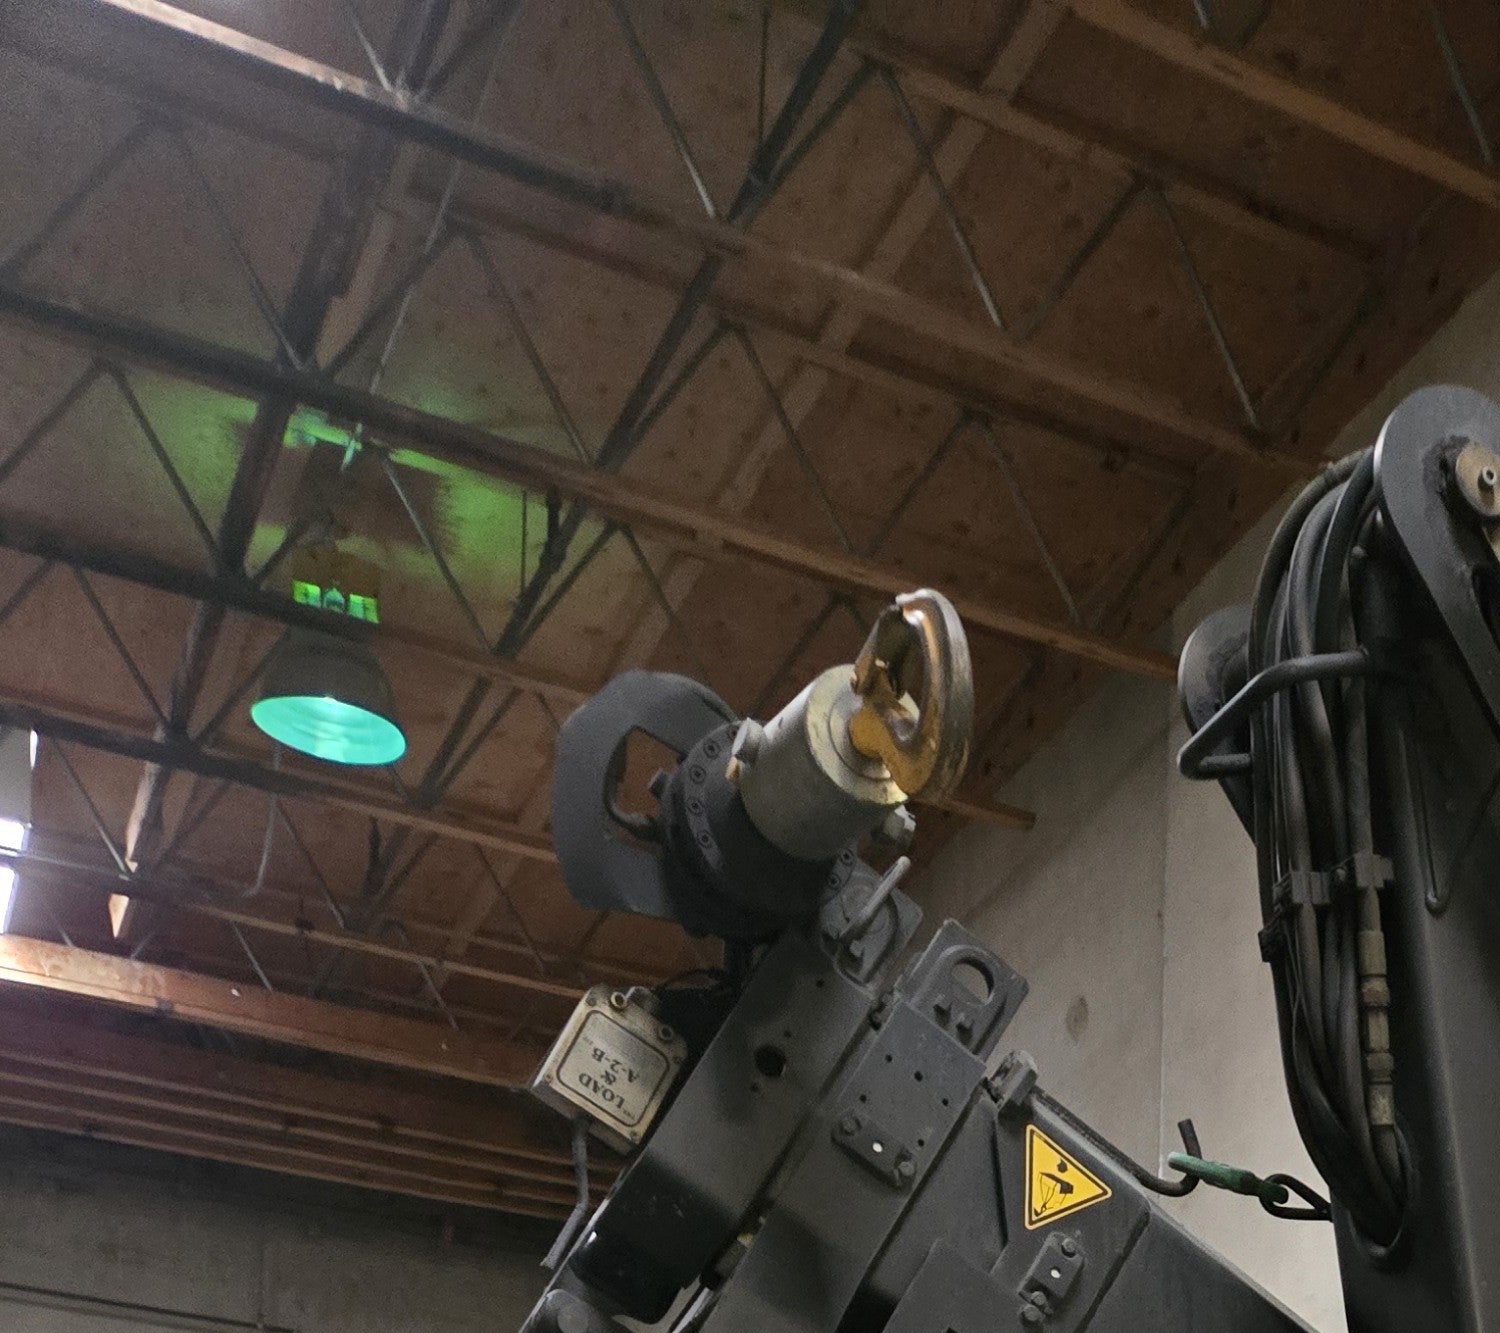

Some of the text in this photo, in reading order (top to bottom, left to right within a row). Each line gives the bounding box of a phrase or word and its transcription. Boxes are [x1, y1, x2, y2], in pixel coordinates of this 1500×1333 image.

[592, 1047, 640, 1083] A-2-B
[600, 1070, 616, 1085] &
[579, 1073, 625, 1109] LOAD
